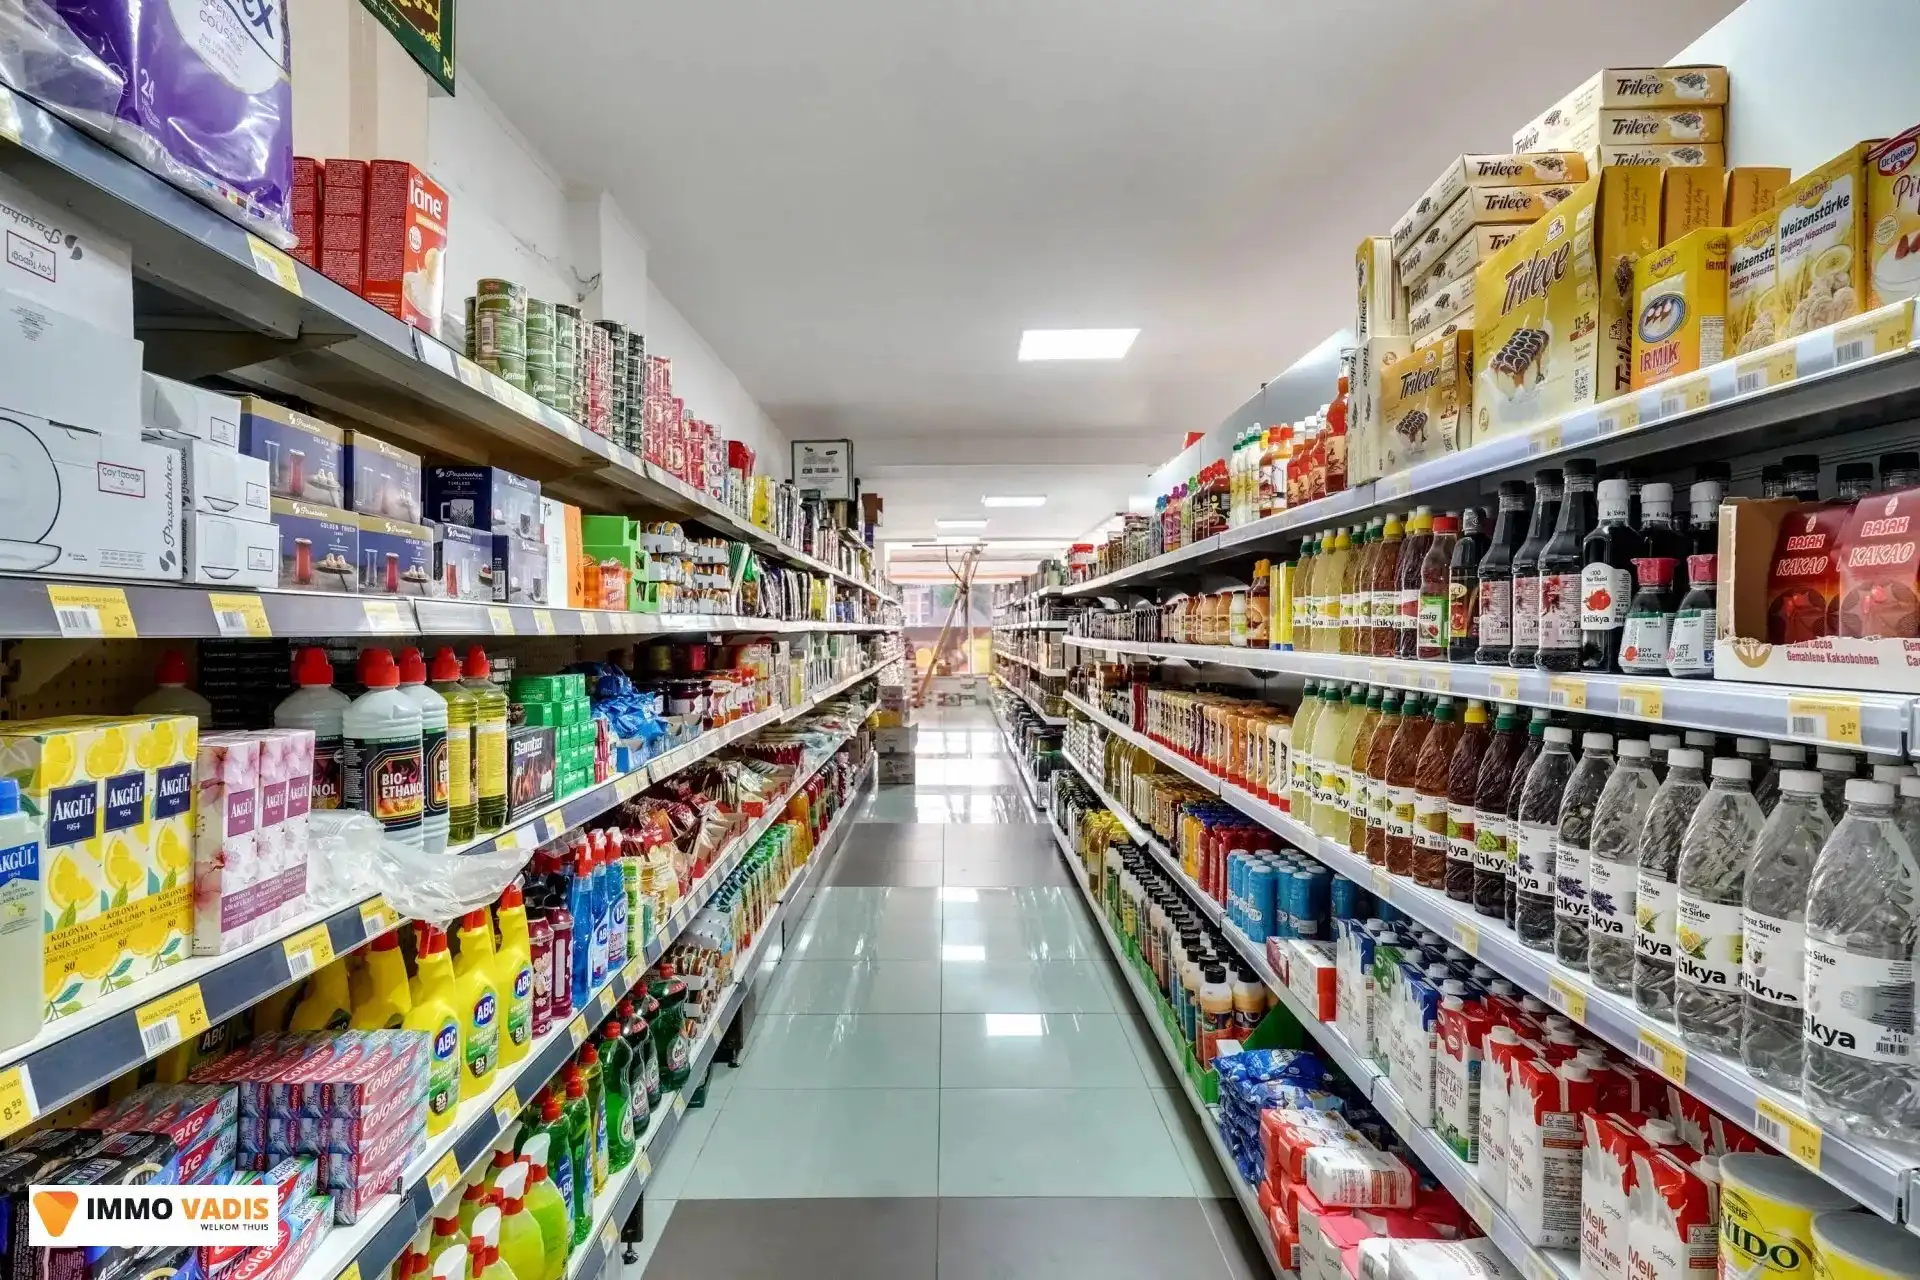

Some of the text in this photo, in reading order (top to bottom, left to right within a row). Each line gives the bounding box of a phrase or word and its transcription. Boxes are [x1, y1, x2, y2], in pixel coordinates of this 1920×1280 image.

[1616, 78, 1664, 98] Trileçe
[1612, 119, 1659, 138] Trileçe
[1476, 161, 1522, 179] Trileçe
[1484, 195, 1532, 213] Trileçe
[1780, 195, 1850, 239] Weizenstärke
[1729, 243, 1775, 277] Weizenstä
[1501, 240, 1571, 317] Trileçe
[1400, 365, 1440, 400] Trileçe
[1776, 556, 1829, 577] KAKAO
[1848, 542, 1915, 567] KAKAO
[1787, 652, 1880, 665] Gemahlene Kakaobohnen
[514, 736, 543, 757] Samba
[159, 772, 191, 797] AKGÜL
[382, 773, 407, 786] BIO-
[107, 779, 143, 808] AKGÜL
[53, 793, 95, 822] AKGÜL
[231, 797, 254, 819] AKGÜL
[167, 919, 176, 929] 80
[1689, 909, 1711, 920] Sirke
[1758, 919, 1782, 934] Sirke
[51, 925, 90, 941] KOLONYA
[118, 939, 127, 949] 80
[64, 960, 75, 973] 80
[1813, 950, 1837, 966] Sirke
[516, 973, 531, 995] ABC
[477, 998, 494, 1022] ABC
[438, 1028, 456, 1056] ABC
[282, 1047, 332, 1082] Colgate
[313, 1047, 362, 1082] Colgate
[343, 1047, 390, 1082] Colgate
[364, 1055, 411, 1098] Colgate
[363, 1086, 410, 1132] Colgate
[361, 1118, 408, 1167] Colgate
[1509, 1134, 1525, 1163] Melk
[361, 1151, 407, 1202] Colgate
[1583, 1201, 1608, 1239] Melk
[1582, 1225, 1622, 1269] Lait Milk
[1720, 1207, 1800, 1269] NIDO
[1628, 1244, 1659, 1280] Melk
